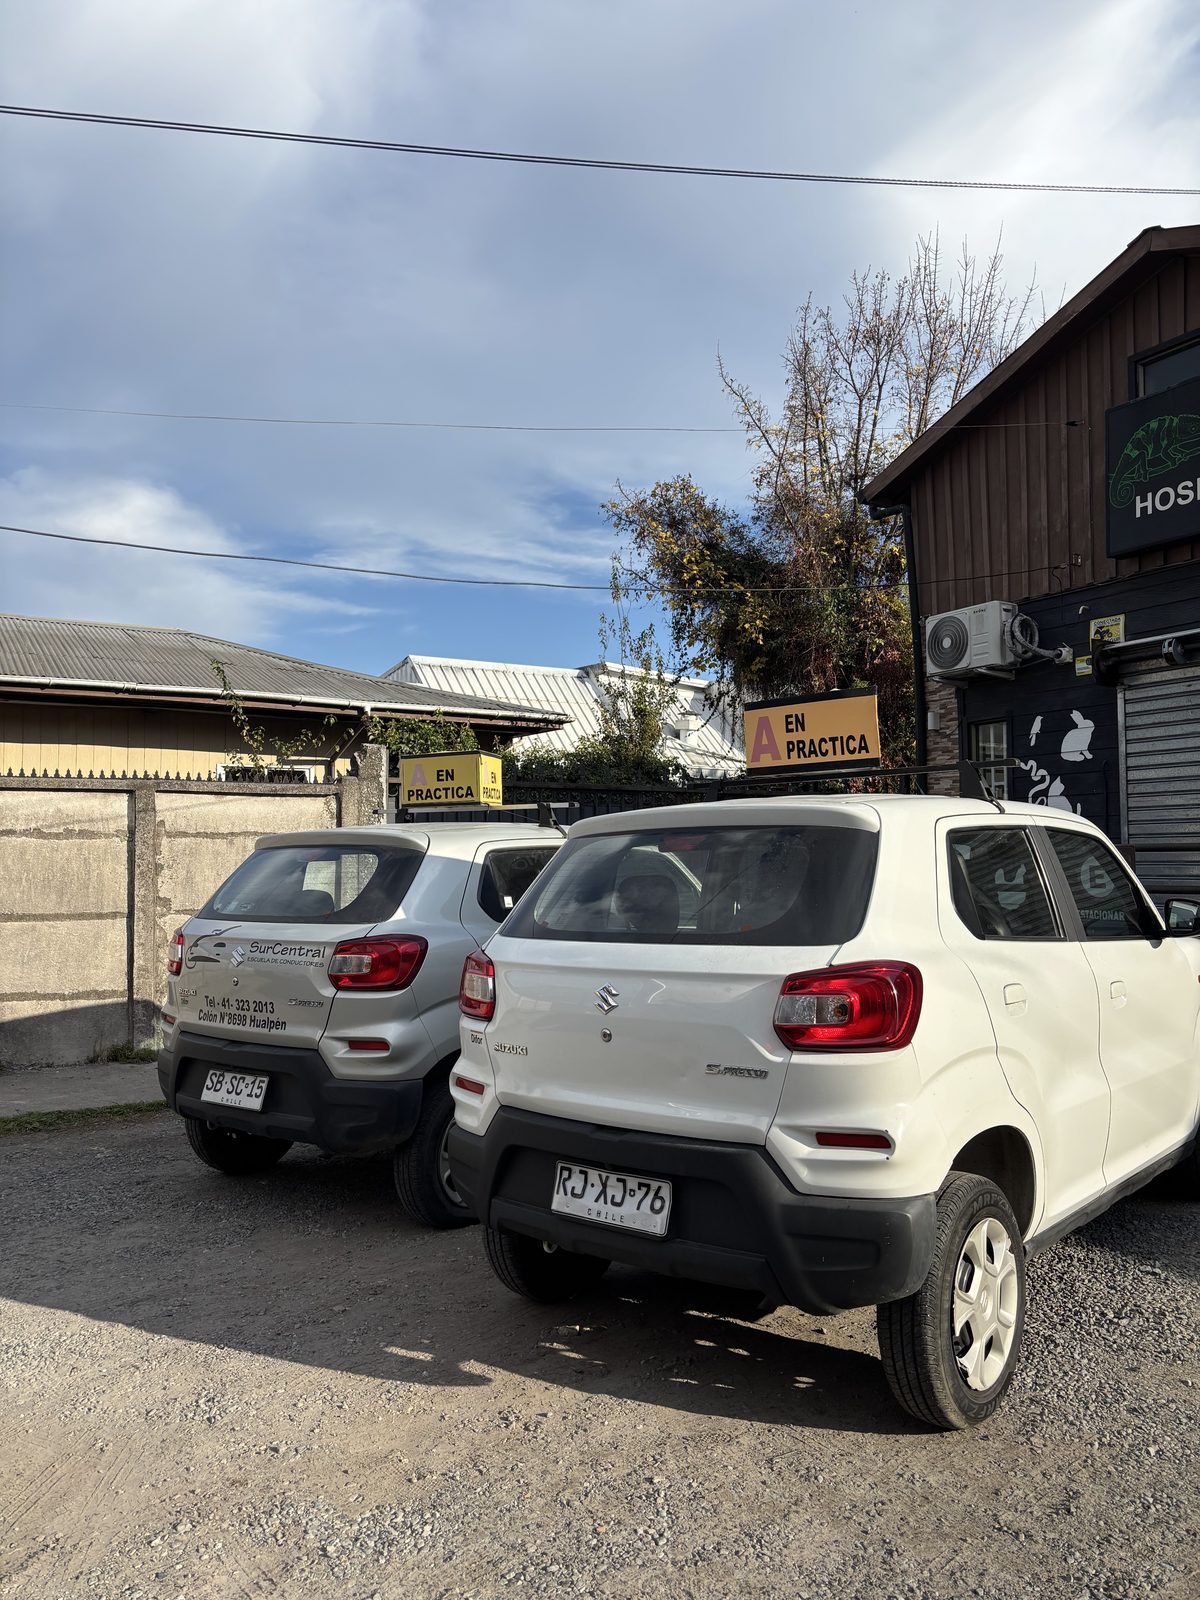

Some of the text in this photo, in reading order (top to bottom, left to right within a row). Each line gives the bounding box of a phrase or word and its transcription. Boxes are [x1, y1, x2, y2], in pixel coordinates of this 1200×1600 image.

[785, 713, 806, 733] EN
[751, 716, 782, 762] A
[786, 734, 869, 759] PRACTICA
[410, 763, 428, 787] A
[436, 769, 455, 782] EN
[490, 771, 497, 784] EN
[407, 786, 474, 801] PRACTICA
[1078, 909, 1125, 920] STACIONAR
[249, 941, 326, 958] SurCentral
[247, 956, 270, 964] ESCUELA
[279, 959, 325, 968] CONDUCTORES
[235, 999, 250, 1012] 323
[252, 1000, 275, 1014] 2013
[198, 1009, 218, 1023] Colón
[249, 1015, 287, 1032] Hualpén
[493, 1041, 529, 1057] SUZUKI
[587, 1208, 625, 1224] CHILE
